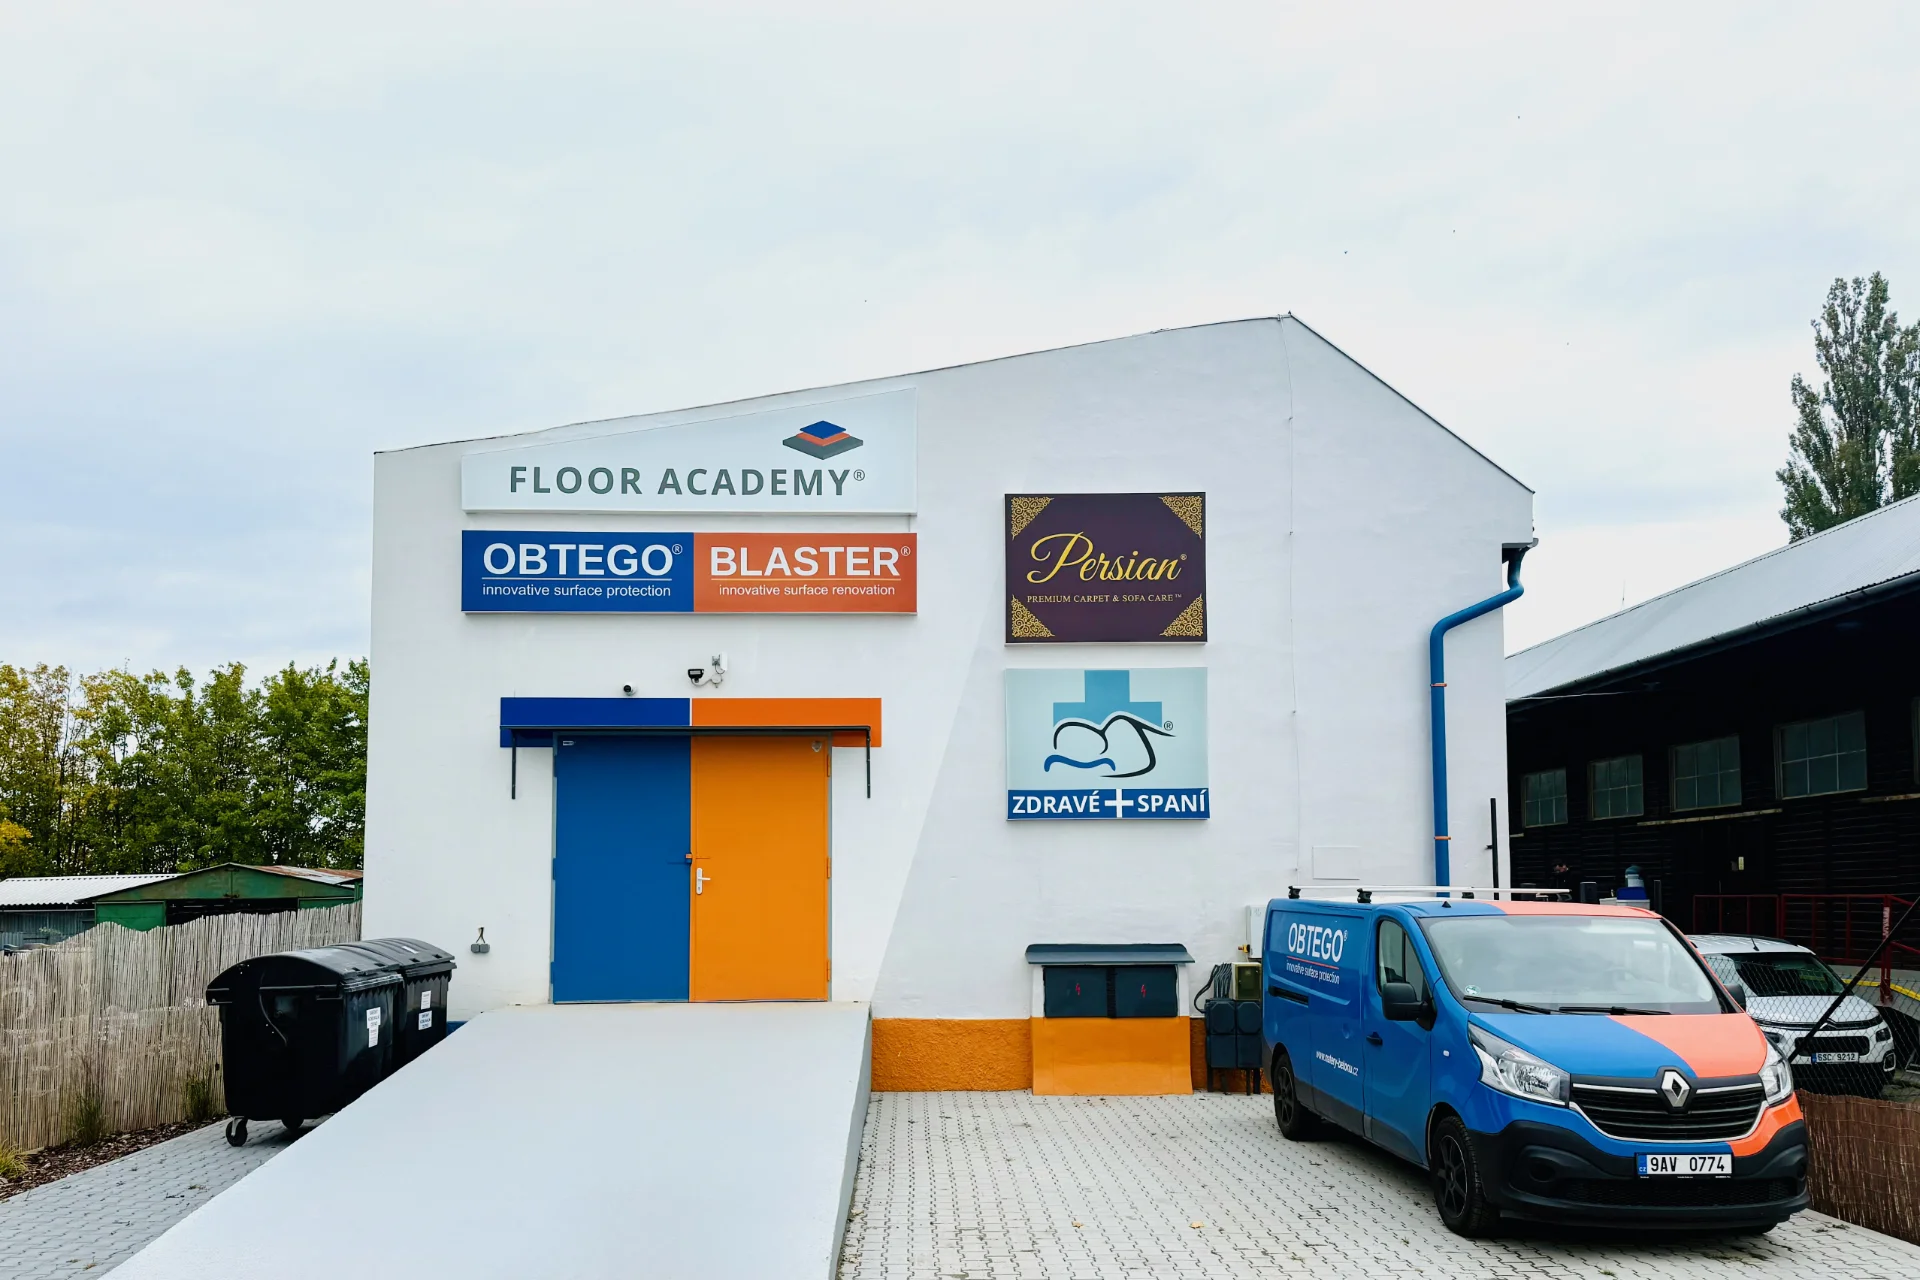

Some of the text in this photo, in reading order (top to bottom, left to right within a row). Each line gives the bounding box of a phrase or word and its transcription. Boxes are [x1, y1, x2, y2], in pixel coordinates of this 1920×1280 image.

[509, 466, 643, 495] FLOOR
[482, 584, 672, 599] innovative surface protection
[719, 584, 896, 596] innovative surface renovation
[1027, 595, 1071, 603] PREMIUM
[1073, 595, 1110, 603] CARPET
[1112, 594, 1119, 603] &
[1122, 594, 1146, 603] SOFA
[1012, 788, 1207, 814] ZDRAVÉ SPANÍ
[1286, 960, 1340, 985] innovative surface protection
[1650, 1156, 1677, 1172] 9AV
[1689, 1156, 1725, 1172] 0774
